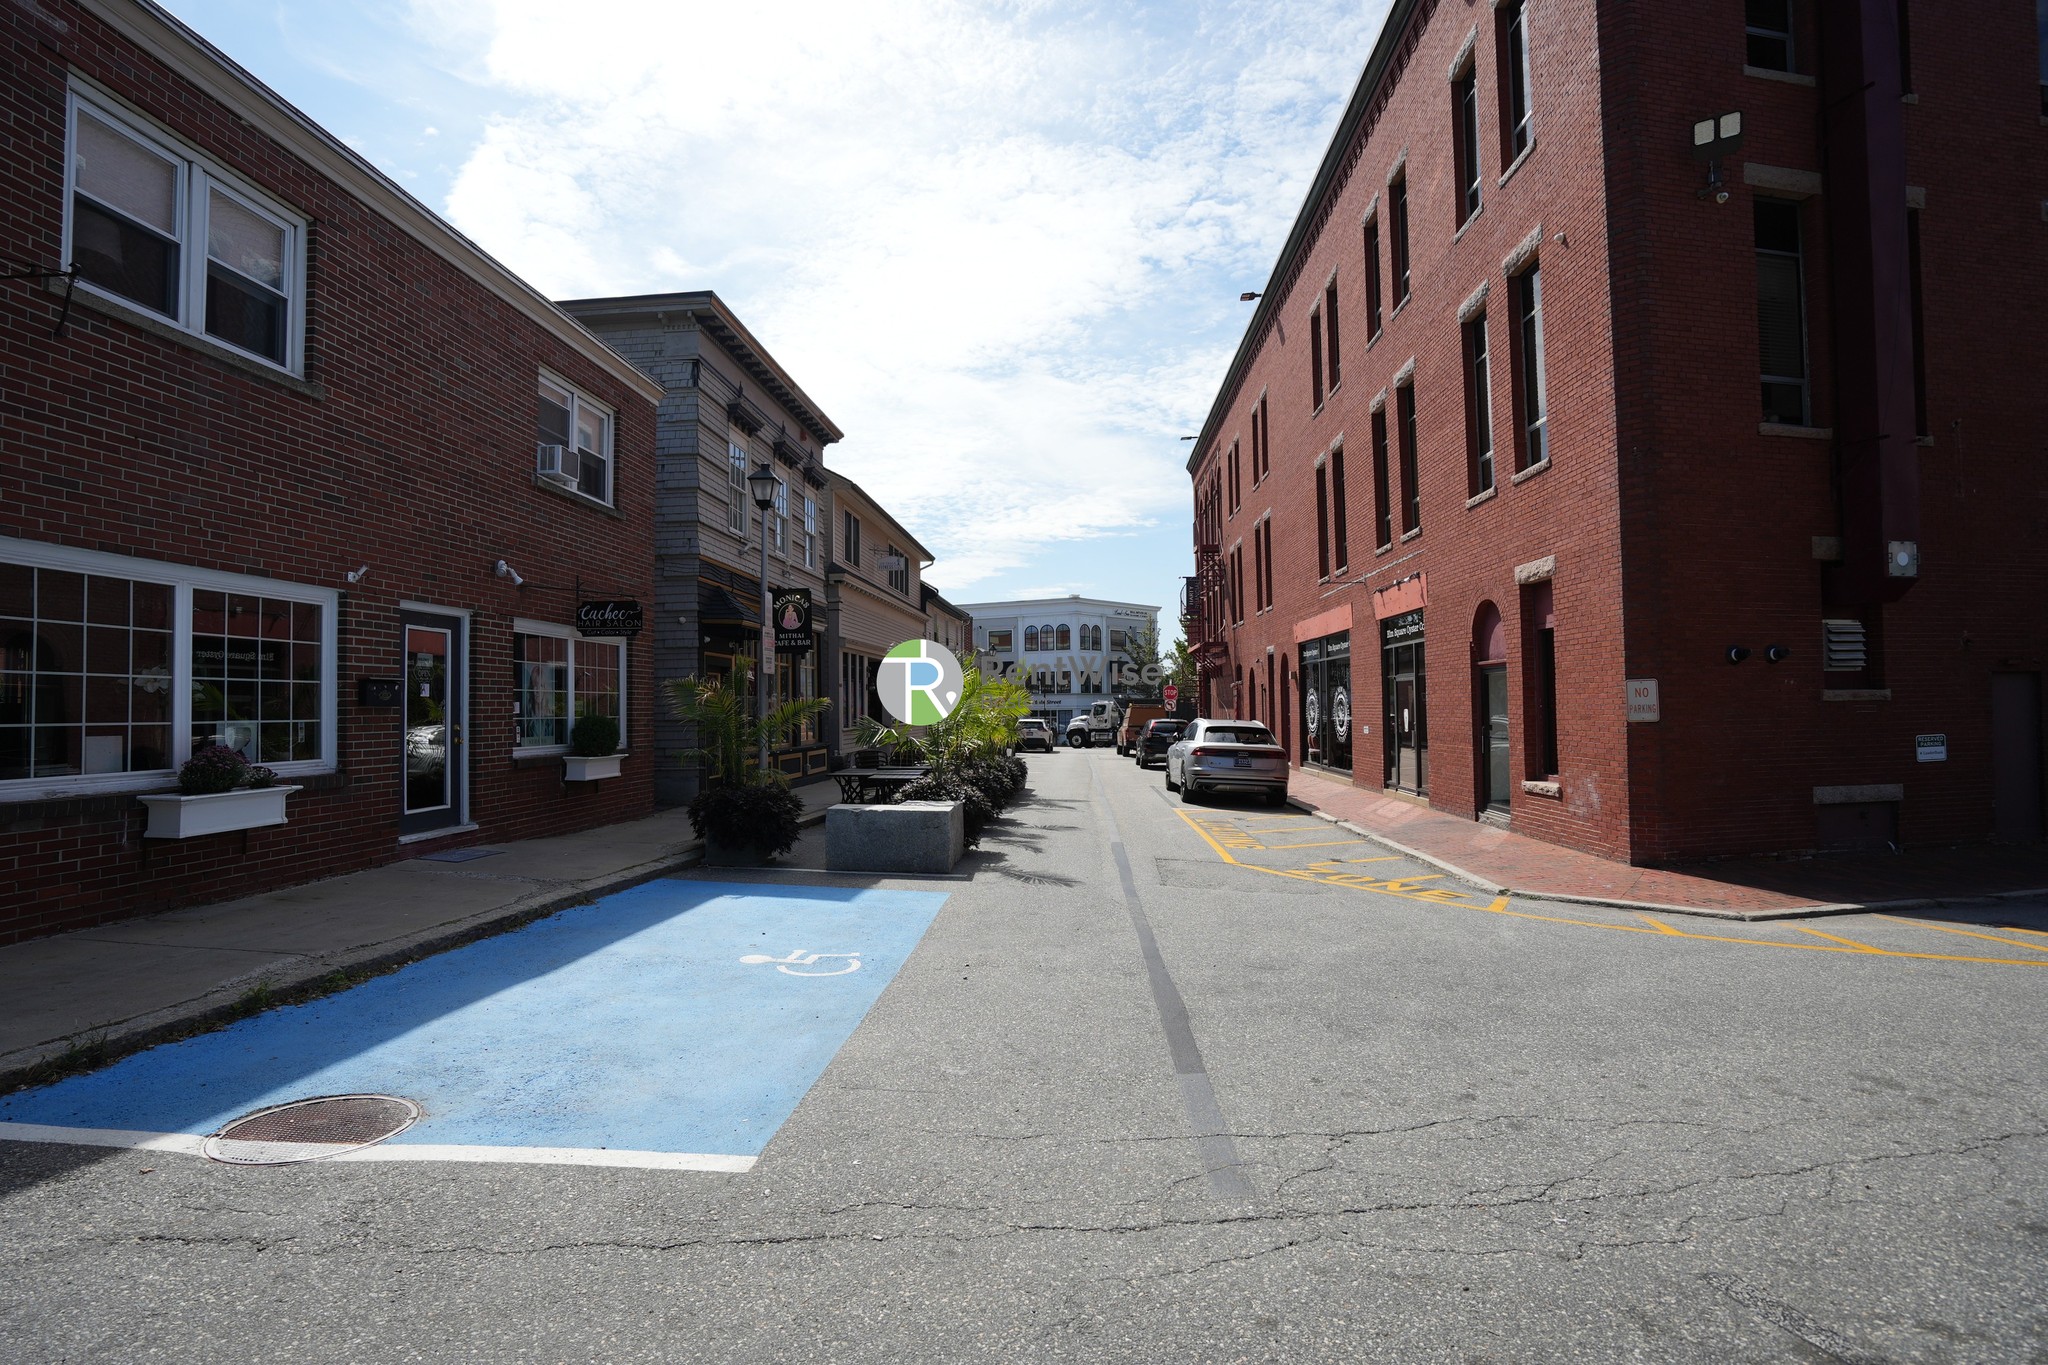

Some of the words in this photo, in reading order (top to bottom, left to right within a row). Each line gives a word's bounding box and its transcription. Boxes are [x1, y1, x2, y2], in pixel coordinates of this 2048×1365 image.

[1635, 687, 1649, 697] NO
[1629, 704, 1656, 713] PARKING
[1284, 862, 1473, 901] ZONE
